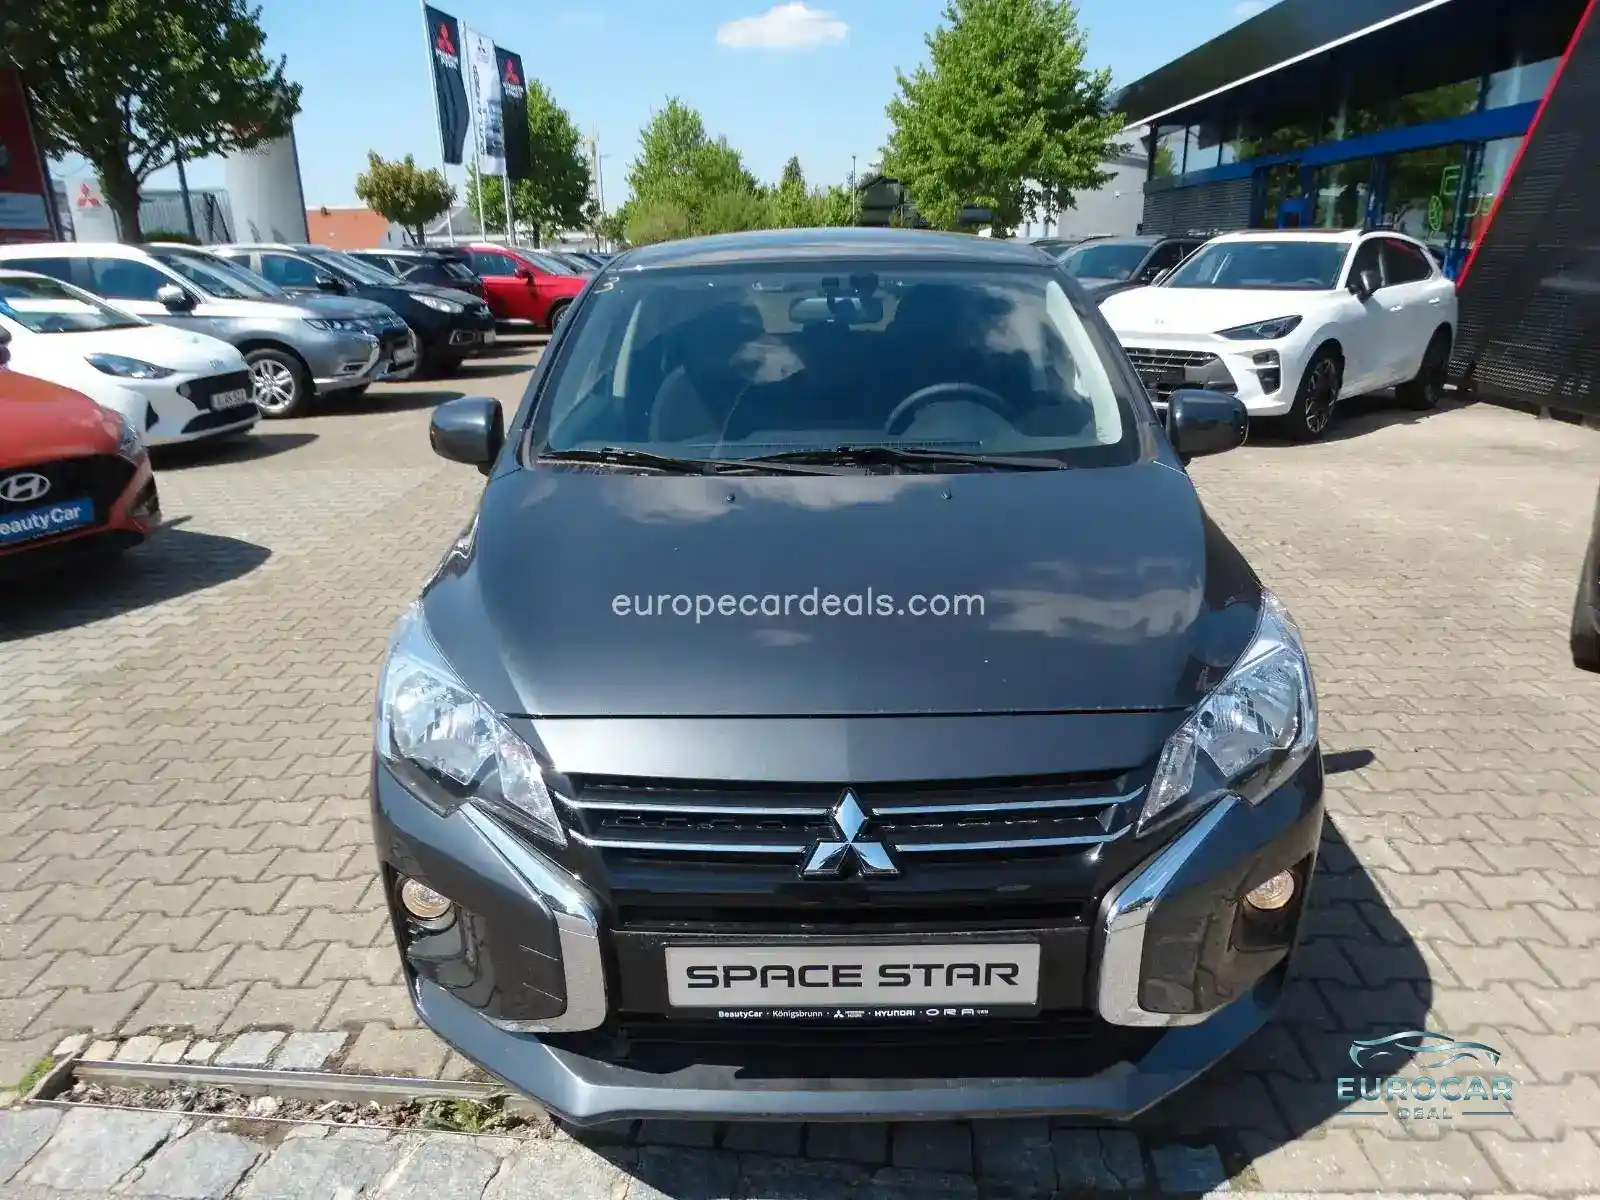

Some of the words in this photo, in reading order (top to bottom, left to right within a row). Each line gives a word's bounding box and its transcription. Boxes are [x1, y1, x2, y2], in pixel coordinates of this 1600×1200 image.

[0, 507, 82, 535] eautyCar
[686, 964, 863, 988] SPACE
[878, 962, 1019, 988] STAR
[718, 1010, 763, 1019] BeautyCar
[772, 1009, 823, 1019] Königsbrunn
